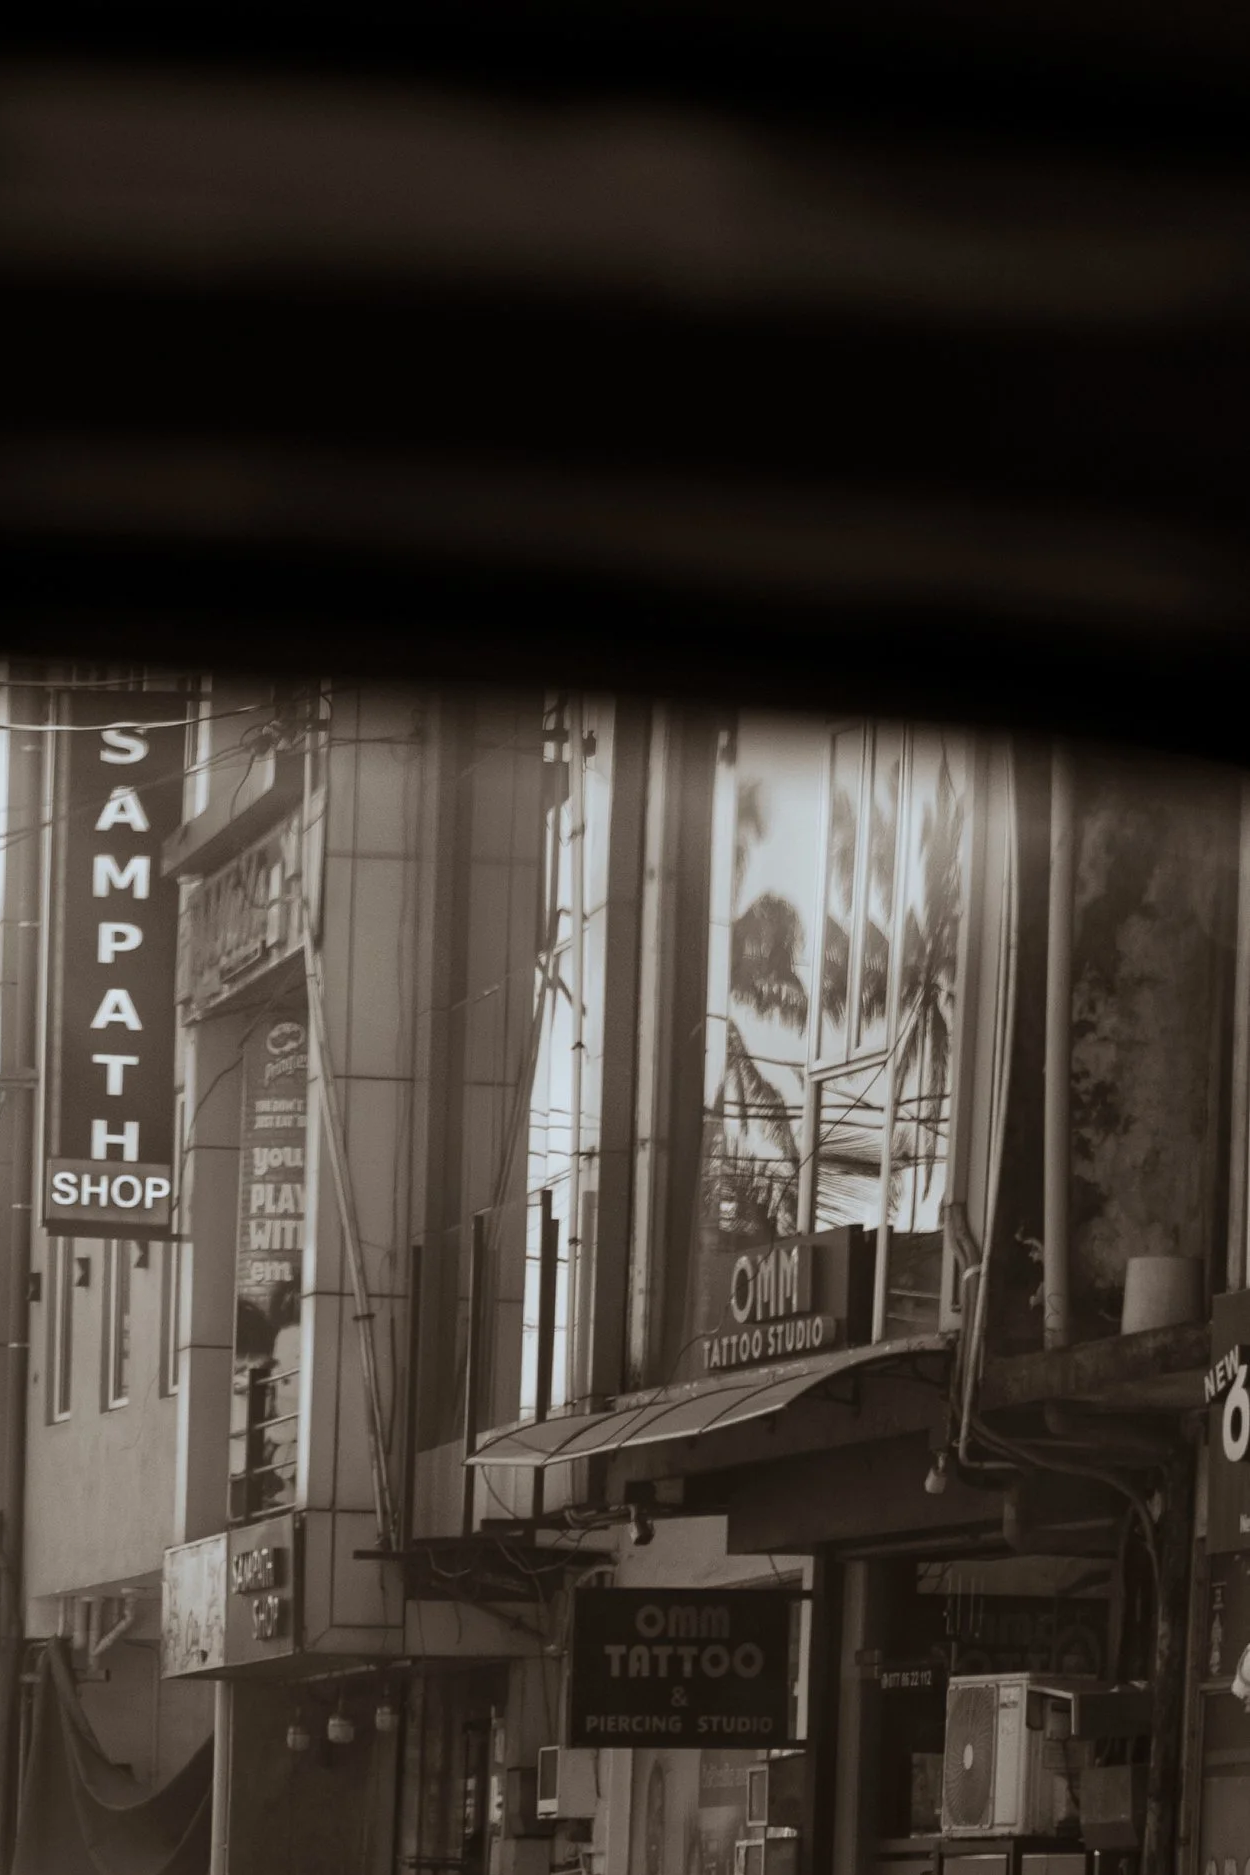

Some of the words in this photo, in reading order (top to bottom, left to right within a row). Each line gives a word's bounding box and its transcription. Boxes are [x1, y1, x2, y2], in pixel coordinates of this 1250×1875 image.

[89, 723, 152, 1162] SAMPATH
[252, 1147, 304, 1176] you
[51, 1171, 171, 1210] SHOP
[730, 1244, 799, 1324] OMM
[702, 1328, 763, 1370] TATTOO
[767, 1315, 824, 1357] STUDIO
[1203, 1344, 1240, 1404] NEW
[603, 1641, 764, 1679] TATTOO
[670, 1685, 689, 1708] &
[585, 1714, 683, 1734] PIERCING
[696, 1715, 774, 1734] STUDIO
